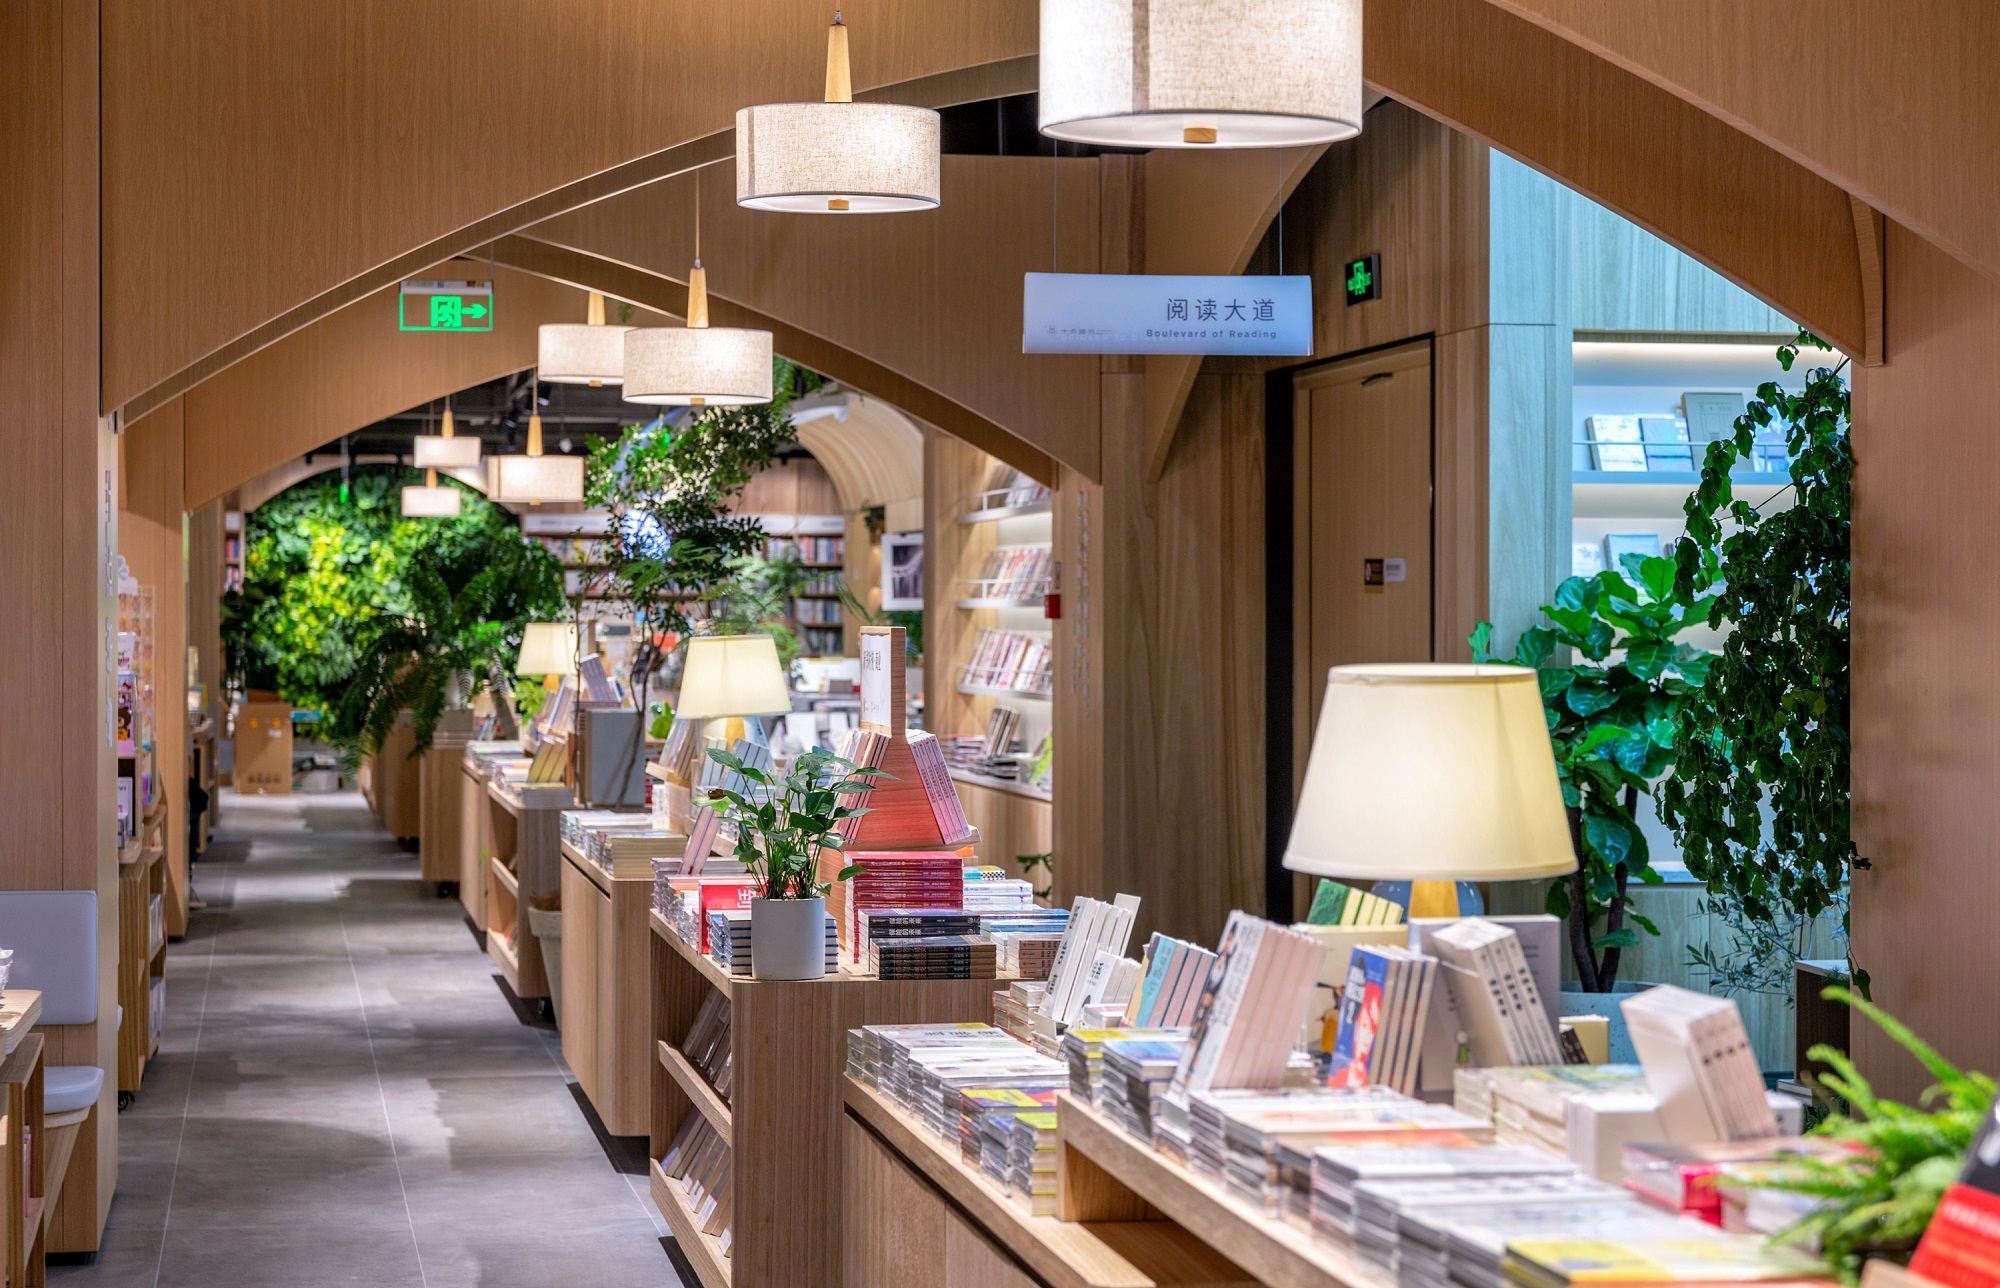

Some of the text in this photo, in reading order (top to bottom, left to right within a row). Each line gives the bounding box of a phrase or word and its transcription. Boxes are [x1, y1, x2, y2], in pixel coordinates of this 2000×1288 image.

[1167, 298, 1275, 321] 阅读大道
[1146, 329, 1207, 338] Boulevard
[1212, 329, 1224, 338] of
[1229, 330, 1277, 340] Reading
